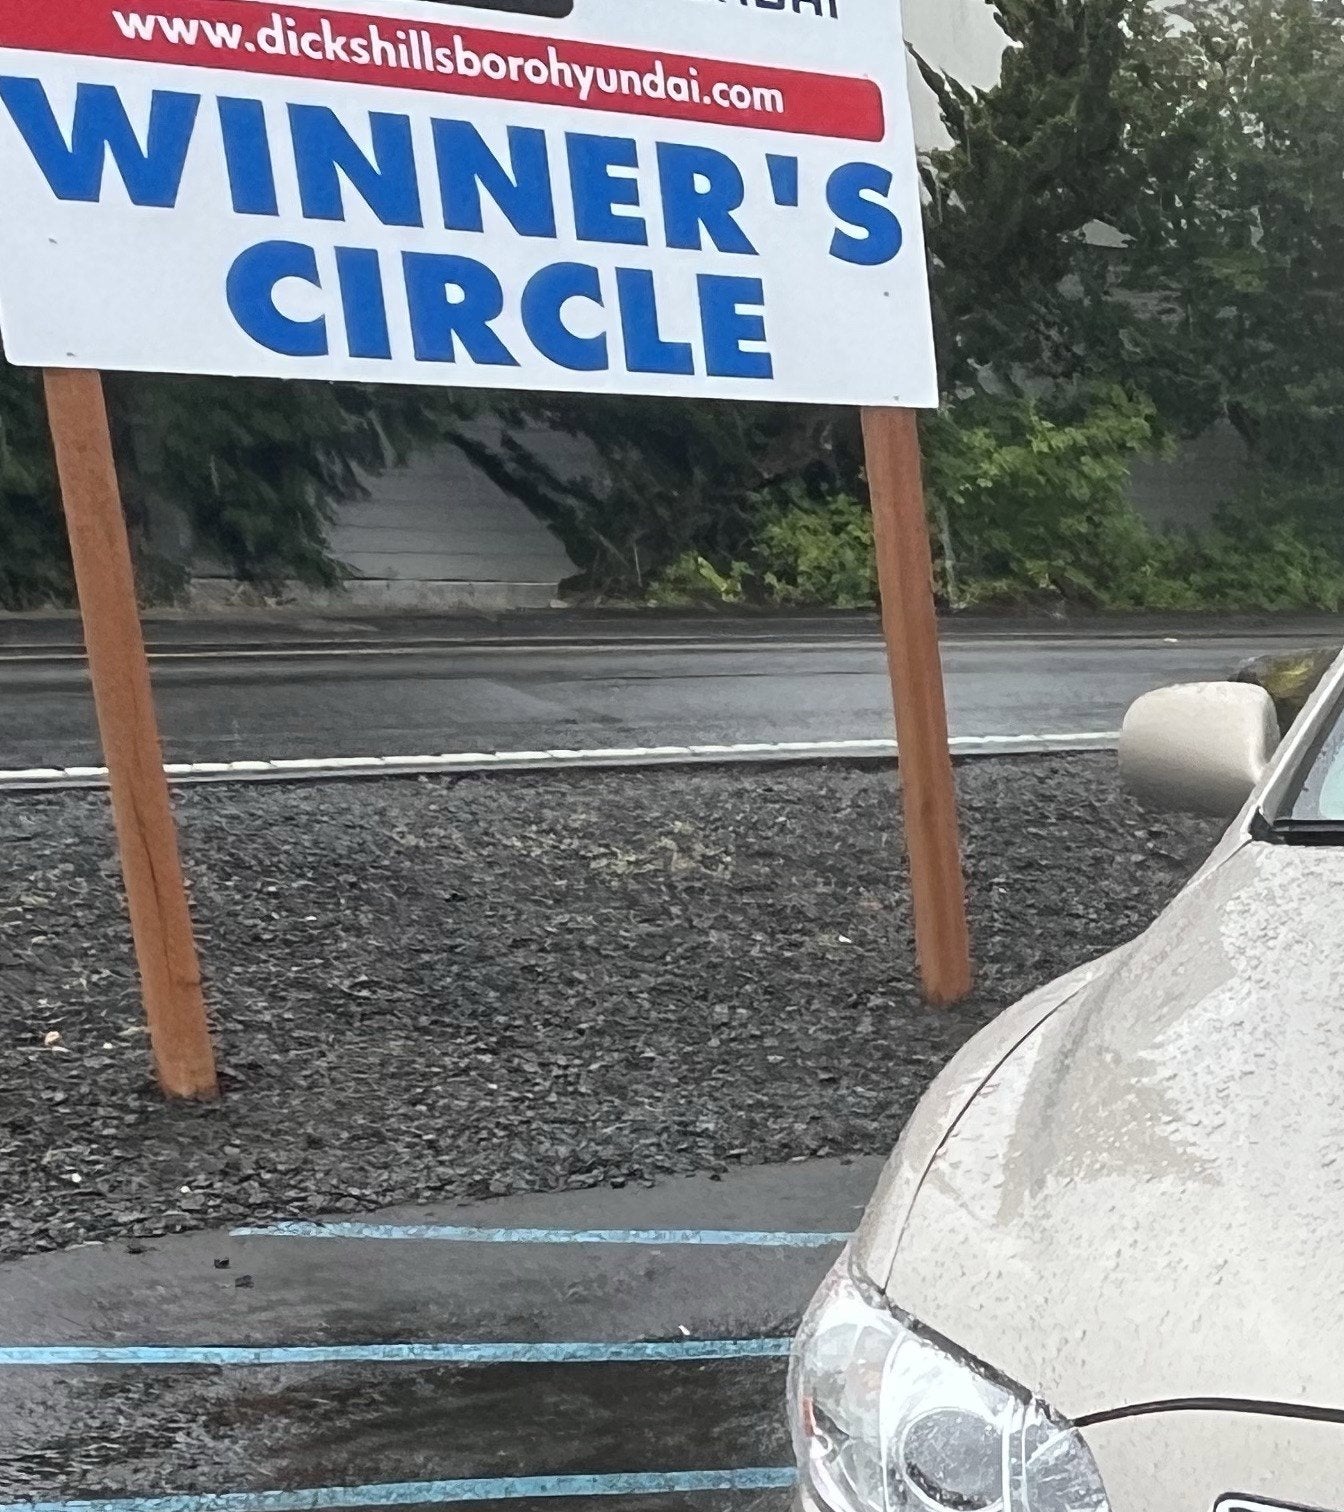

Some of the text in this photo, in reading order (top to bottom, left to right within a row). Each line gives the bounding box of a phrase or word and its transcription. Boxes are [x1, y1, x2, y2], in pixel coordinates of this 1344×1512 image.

[112, 10, 785, 116] www.dickshillsborohyundai.com
[0, 75, 904, 267] WINNER'S
[225, 240, 774, 380] CIRCLE
